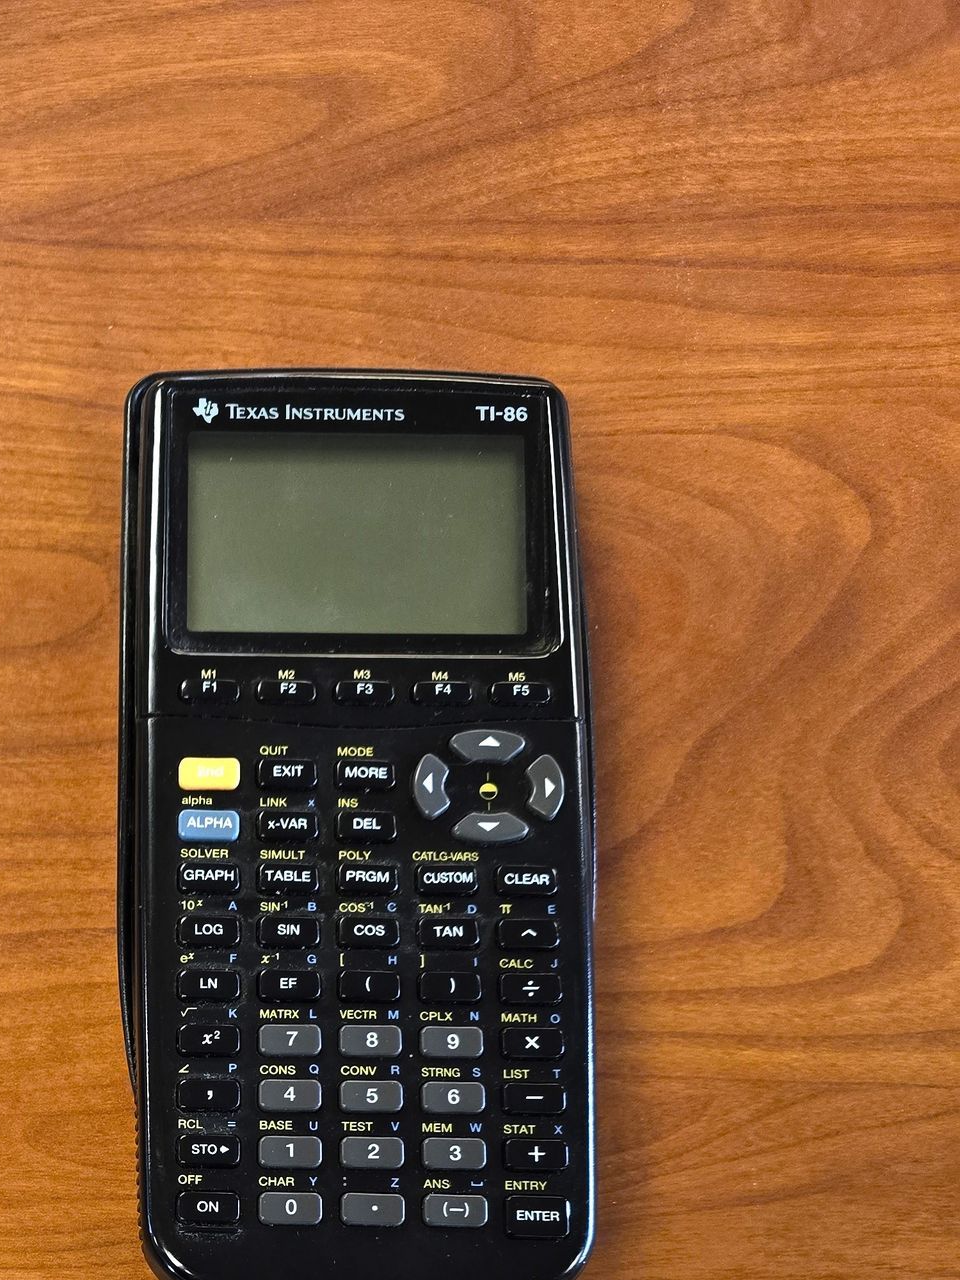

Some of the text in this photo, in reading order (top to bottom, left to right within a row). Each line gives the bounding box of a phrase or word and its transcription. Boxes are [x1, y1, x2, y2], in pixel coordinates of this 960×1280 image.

[225, 404, 404, 421] TEXAS INSTRUMENTS
[476, 406, 527, 421] TI-86
[202, 669, 216, 679] M1
[279, 670, 294, 679] M2
[354, 670, 370, 679] M3
[432, 672, 448, 680] M4
[509, 672, 525, 681] M5
[203, 681, 216, 692] F1
[281, 682, 296, 693] F2
[357, 683, 373, 694] F3
[435, 684, 451, 694] F4
[513, 685, 529, 695] F5
[260, 746, 288, 755] QUIT
[338, 747, 373, 756] MODE
[273, 765, 303, 776] EXIT
[345, 767, 387, 778] MORE
[182, 796, 212, 806] alpha
[260, 798, 286, 807] LINK
[338, 799, 358, 807] INS
[187, 817, 232, 830] ALPHA
[268, 818, 307, 829] x-VAR
[353, 818, 381, 829] DEL
[181, 849, 228, 858] SOLVER
[260, 850, 305, 859] SIMULT
[339, 851, 371, 860] POLY
[413, 851, 479, 861] CATLG-VARS
[184, 870, 234, 881] GRAPH
[265, 870, 310, 882] TABLE
[346, 871, 389, 882] PRGM
[424, 872, 473, 883] CUSTOM
[505, 873, 549, 885] CLEAR
[195, 924, 223, 935] LOG
[278, 924, 299, 935] SIN
[354, 925, 385, 936] COS
[433, 926, 463, 937] TAN
[500, 959, 533, 968] CALC
[200, 978, 217, 988] LN
[280, 978, 297, 988] EF
[260, 1009, 299, 1018] MATRX
[340, 1010, 376, 1019] VECTR
[420, 1012, 452, 1021] CPLX
[502, 1013, 536, 1022] MATH
[286, 1031, 298, 1046] 7
[366, 1032, 378, 1047] 8
[447, 1034, 459, 1049] 9
[260, 1065, 296, 1075] CONS
[341, 1066, 376, 1075] CONV
[422, 1067, 460, 1077] STRNG
[504, 1069, 529, 1078] LIST
[284, 1087, 295, 1101] 4
[367, 1089, 378, 1103] 5
[448, 1089, 459, 1104] 6
[178, 1119, 203, 1128] RCL
[260, 1121, 292, 1130] BASE
[341, 1122, 373, 1131] TEST
[422, 1123, 452, 1132] MEM
[504, 1125, 535, 1134] STAT
[286, 1144, 293, 1157] 1
[368, 1144, 379, 1158] 2
[450, 1146, 461, 1160] 3
[178, 1175, 202, 1184] OFF
[259, 1177, 294, 1186] CHAR
[424, 1179, 450, 1189] ANS
[505, 1181, 547, 1190] ENTRY
[197, 1201, 218, 1212] ON
[286, 1199, 297, 1214] 0
[517, 1210, 559, 1221] ENTER
